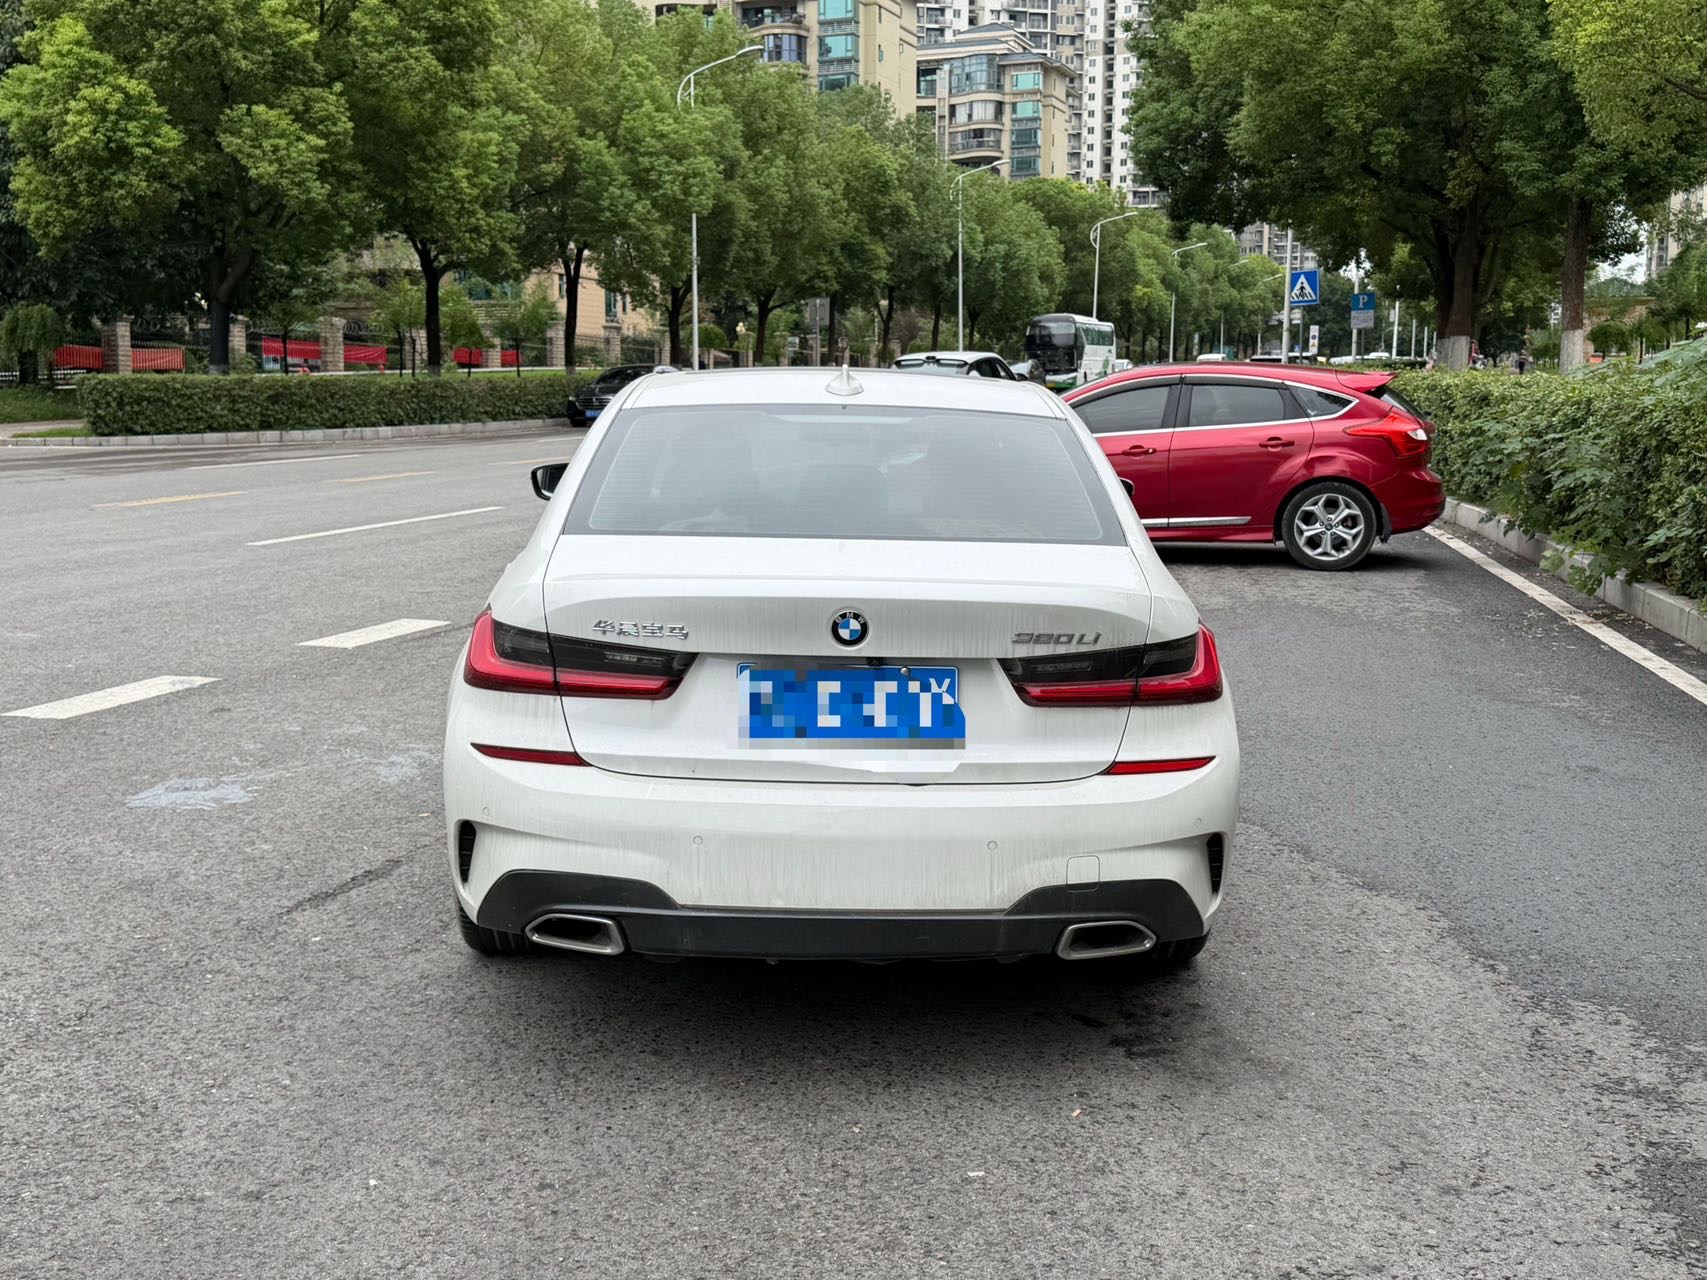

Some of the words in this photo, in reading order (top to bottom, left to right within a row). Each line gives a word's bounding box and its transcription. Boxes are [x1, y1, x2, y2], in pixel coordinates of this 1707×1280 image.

[835, 612, 866, 624] BMW
[592, 620, 689, 640] 华晨宝马
